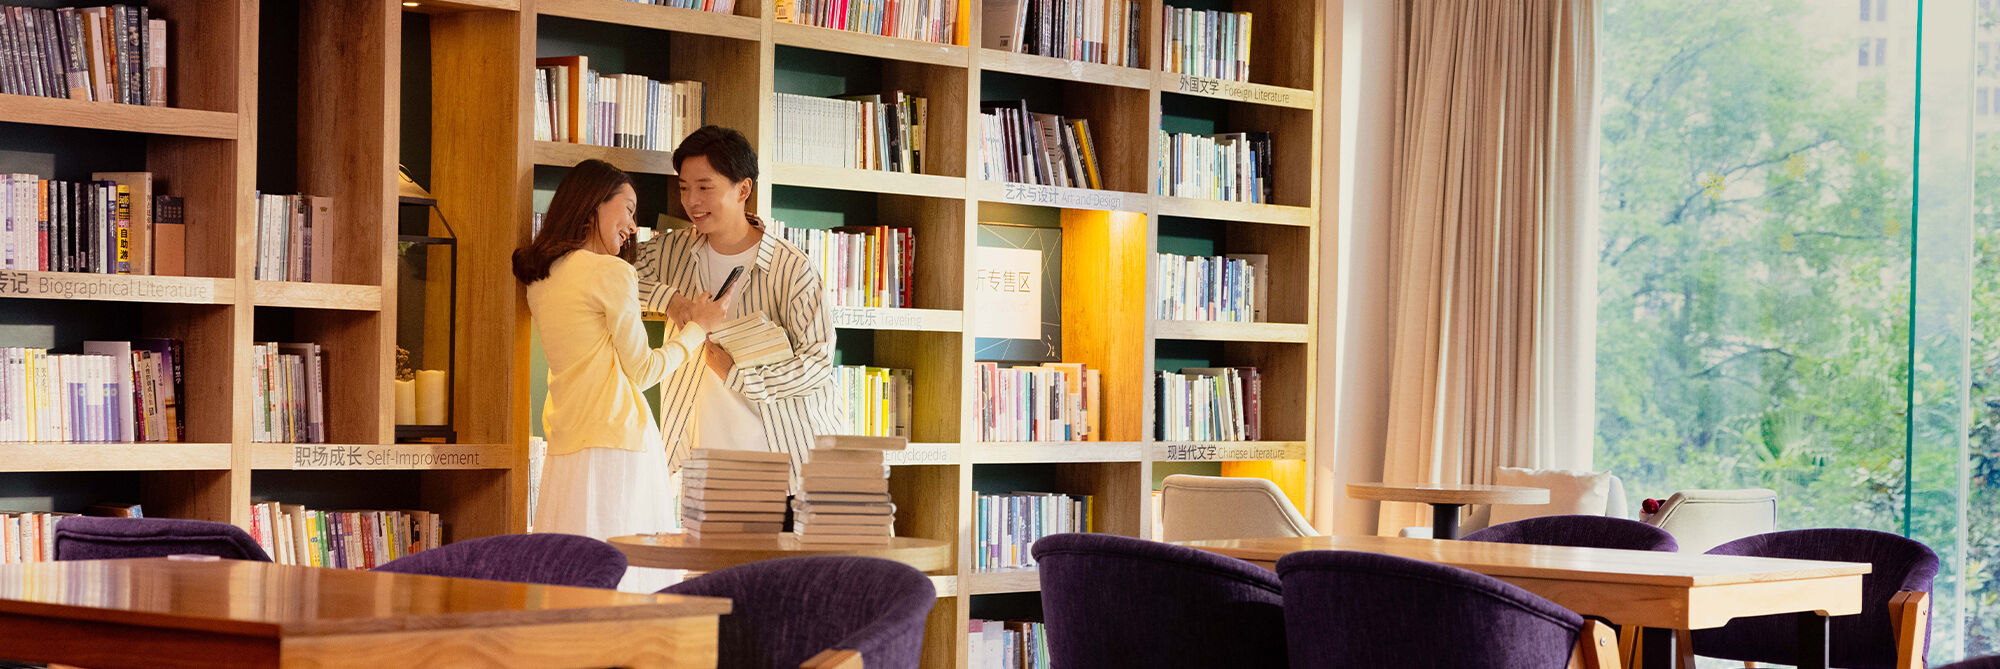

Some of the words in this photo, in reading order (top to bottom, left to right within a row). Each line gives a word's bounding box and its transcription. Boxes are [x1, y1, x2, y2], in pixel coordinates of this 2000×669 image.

[1179, 75, 1219, 96] 外国文学
[1224, 84, 1253, 102] Foreign
[1254, 88, 1290, 103] Literature
[1005, 183, 1059, 204] 艺术与设计
[1061, 193, 1074, 203] Art
[1075, 194, 1092, 206] and
[1094, 193, 1121, 210] Design
[120, 228, 128, 260] 自助游
[39, 276, 134, 299] Biographical
[138, 280, 207, 299] Literature
[880, 313, 922, 329] Traveling
[295, 446, 362, 467] 职场成长
[366, 449, 480, 468] Self-Improvement
[885, 447, 947, 464] Encyclopedia
[1167, 445, 1216, 460] 现当代文学
[1218, 446, 1248, 459] Chinese
[1249, 448, 1285, 459] Literature
